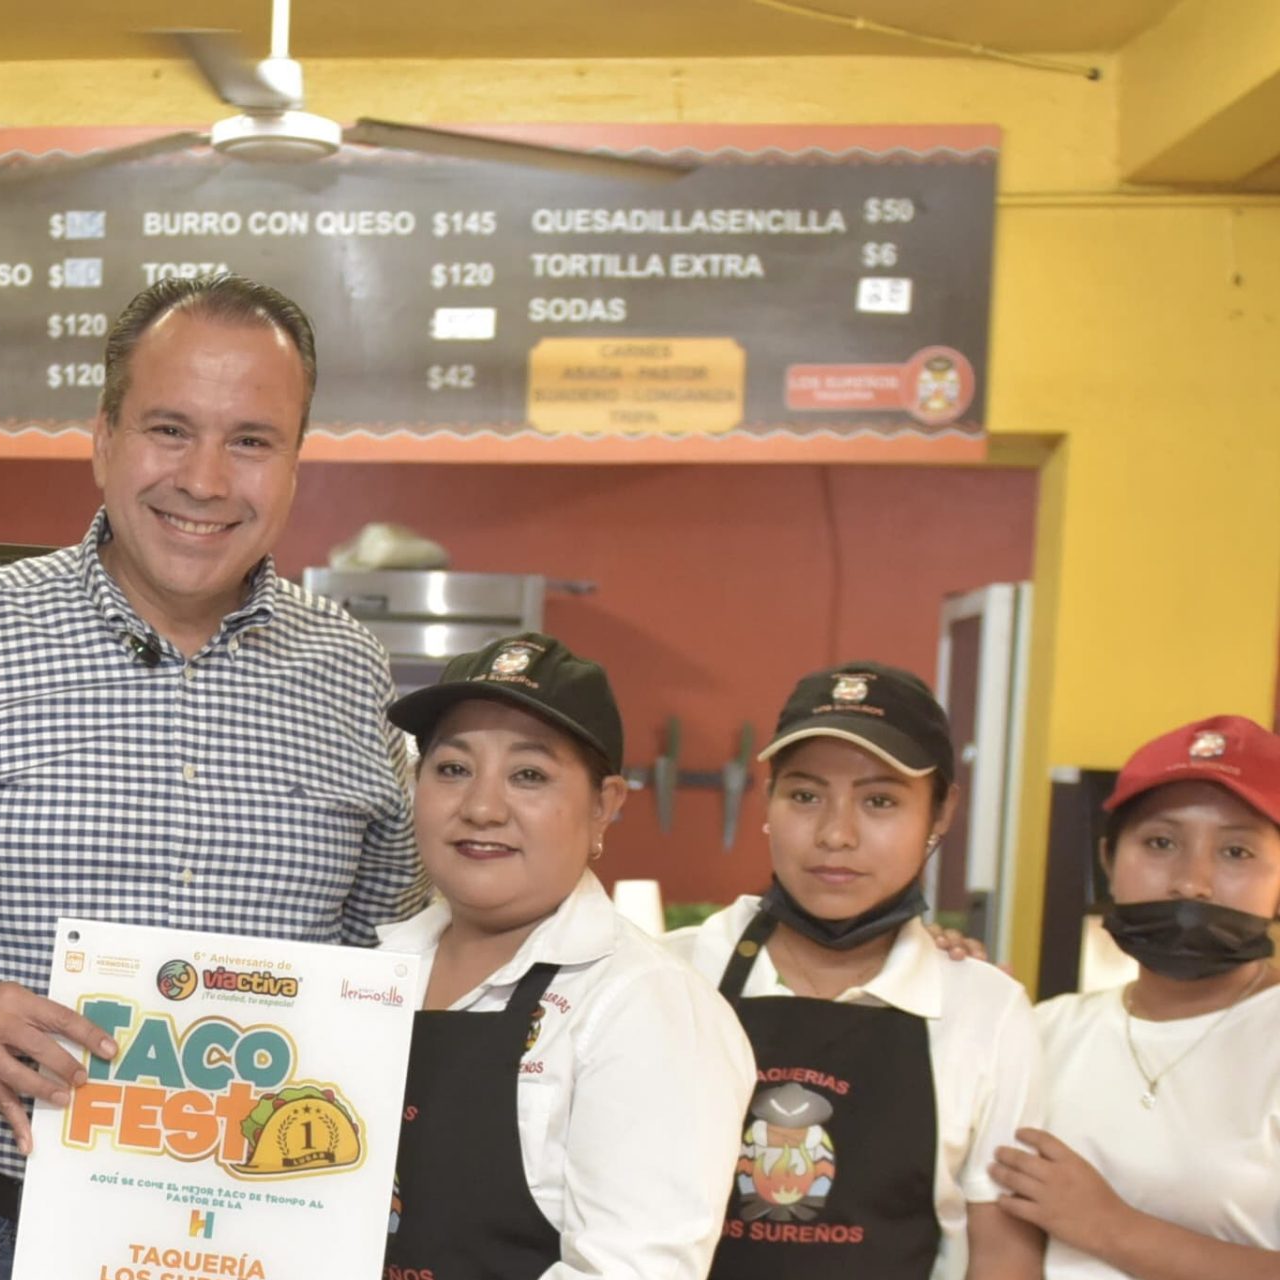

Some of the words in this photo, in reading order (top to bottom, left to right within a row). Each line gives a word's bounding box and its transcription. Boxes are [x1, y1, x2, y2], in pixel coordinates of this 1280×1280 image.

[864, 197, 915, 223] $50
[144, 211, 241, 236] BURRO
[248, 211, 309, 236] CON
[316, 210, 415, 237] QUESO
[433, 210, 497, 238] $145
[531, 253, 664, 278] TORTILLA
[671, 254, 764, 278] EXTRA
[862, 241, 898, 267] $6
[431, 263, 495, 289] $120
[529, 298, 627, 323] SODAS
[47, 313, 107, 338] $120
[46, 363, 106, 389] $120
[427, 365, 475, 390] $42
[210, 953, 274, 968] Aniversario
[276, 960, 292, 970] de
[82, 999, 291, 1091] TACO
[300, 1120, 317, 1151] 1
[137, 1179, 164, 1189] COME
[181, 1185, 214, 1196] MEJOR
[217, 1187, 246, 1199] TACO
[249, 1192, 261, 1201] DE
[212, 1198, 224, 1207] DE
[227, 1201, 242, 1210] LA
[750, 1221, 864, 1244] SUREÑOS
[129, 1244, 265, 1280] TAQUERÍA
